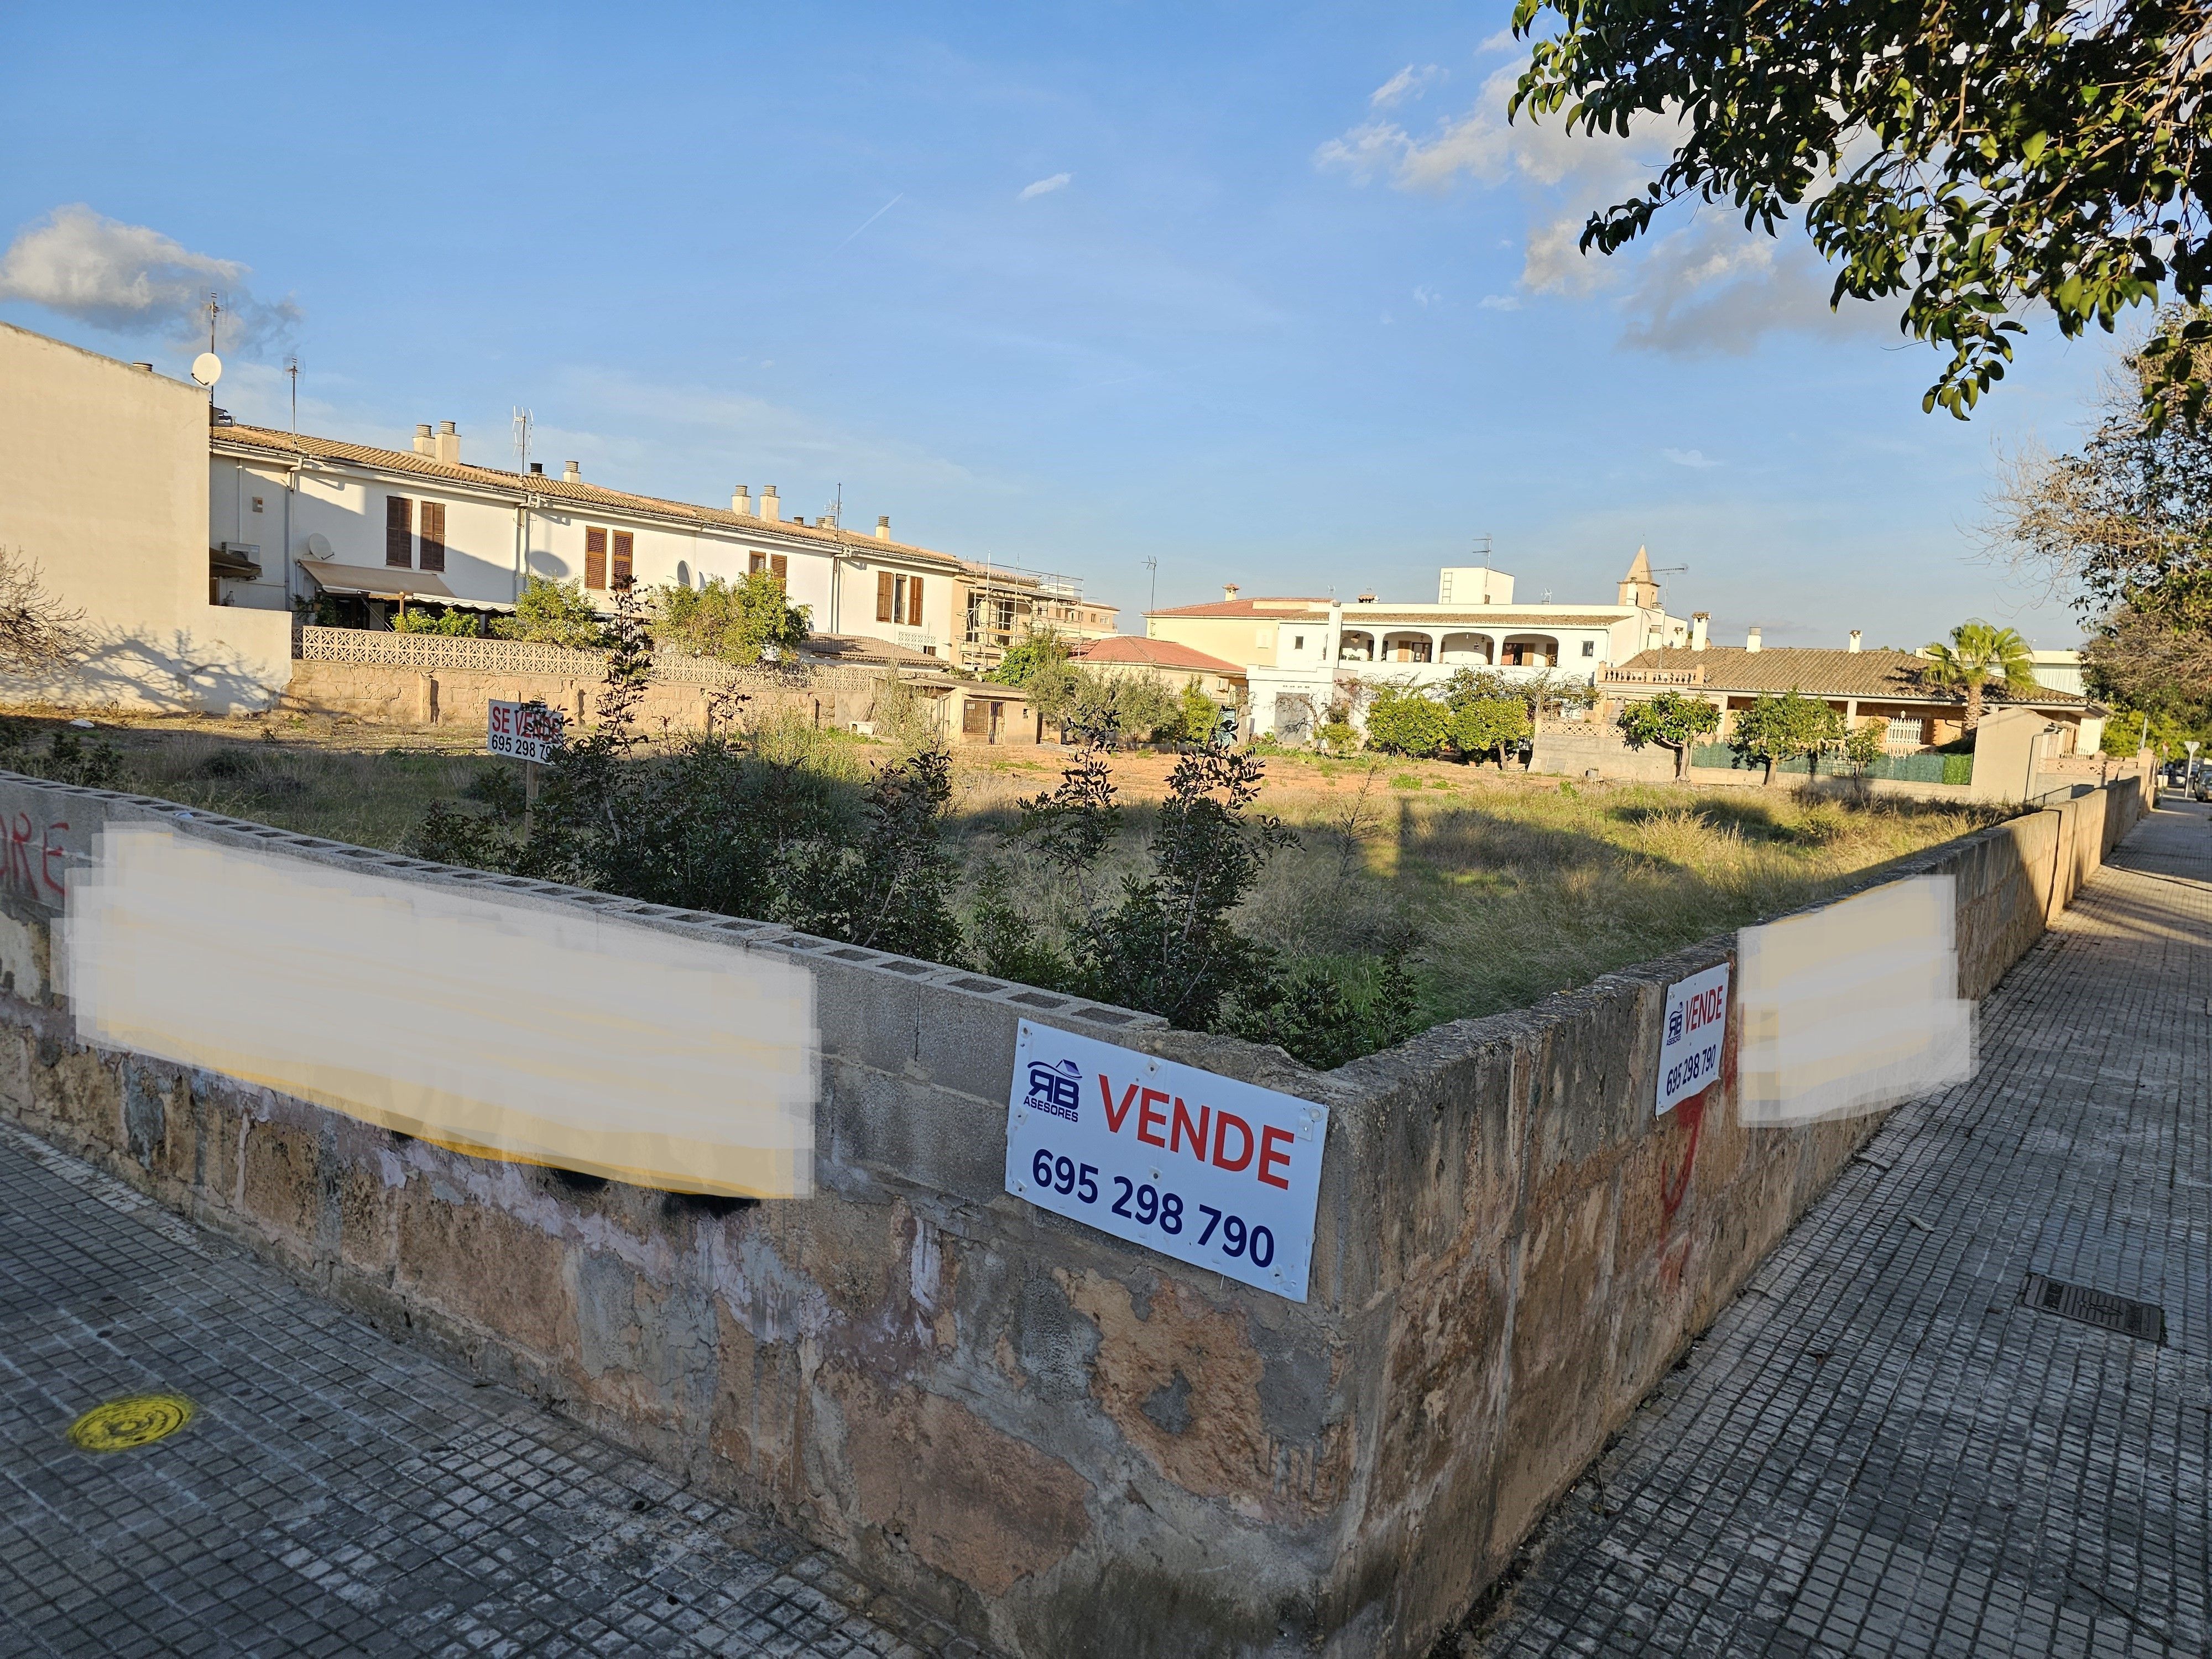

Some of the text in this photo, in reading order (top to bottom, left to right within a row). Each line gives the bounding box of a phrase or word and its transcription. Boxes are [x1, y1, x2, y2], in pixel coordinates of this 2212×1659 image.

[492, 706, 510, 733] SE
[492, 734, 512, 752] 695
[515, 739, 535, 757] 298
[1686, 985, 1723, 1034] VENDE
[1667, 1044, 1716, 1096] 695 298 790
[1024, 1096, 1078, 1123] ASESORES
[1099, 1074, 1295, 1190] VENDE
[1032, 1149, 1274, 1268] 695 298 790
